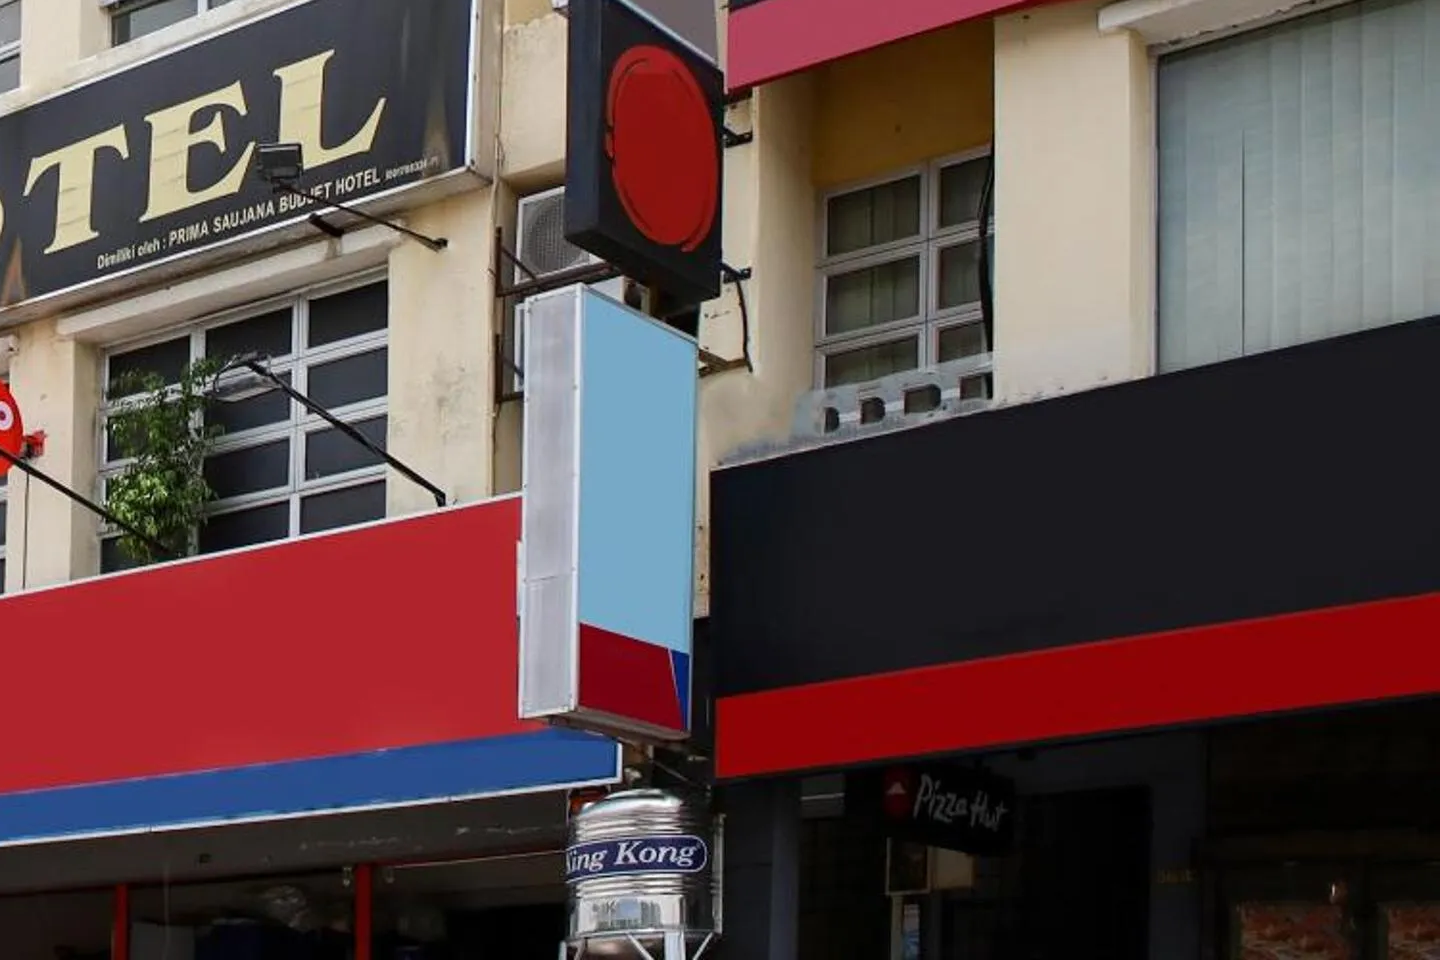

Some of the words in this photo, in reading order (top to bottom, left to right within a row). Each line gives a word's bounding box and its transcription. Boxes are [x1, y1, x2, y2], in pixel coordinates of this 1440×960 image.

[96, 246, 136, 270] Dimiliki
[168, 220, 210, 247] PRIMA
[213, 200, 275, 233] SAUJANA
[335, 168, 381, 196] HOTEL
[912, 772, 969, 824] Pizza
[966, 789, 1010, 833] Hut
[613, 840, 697, 868] Kong
